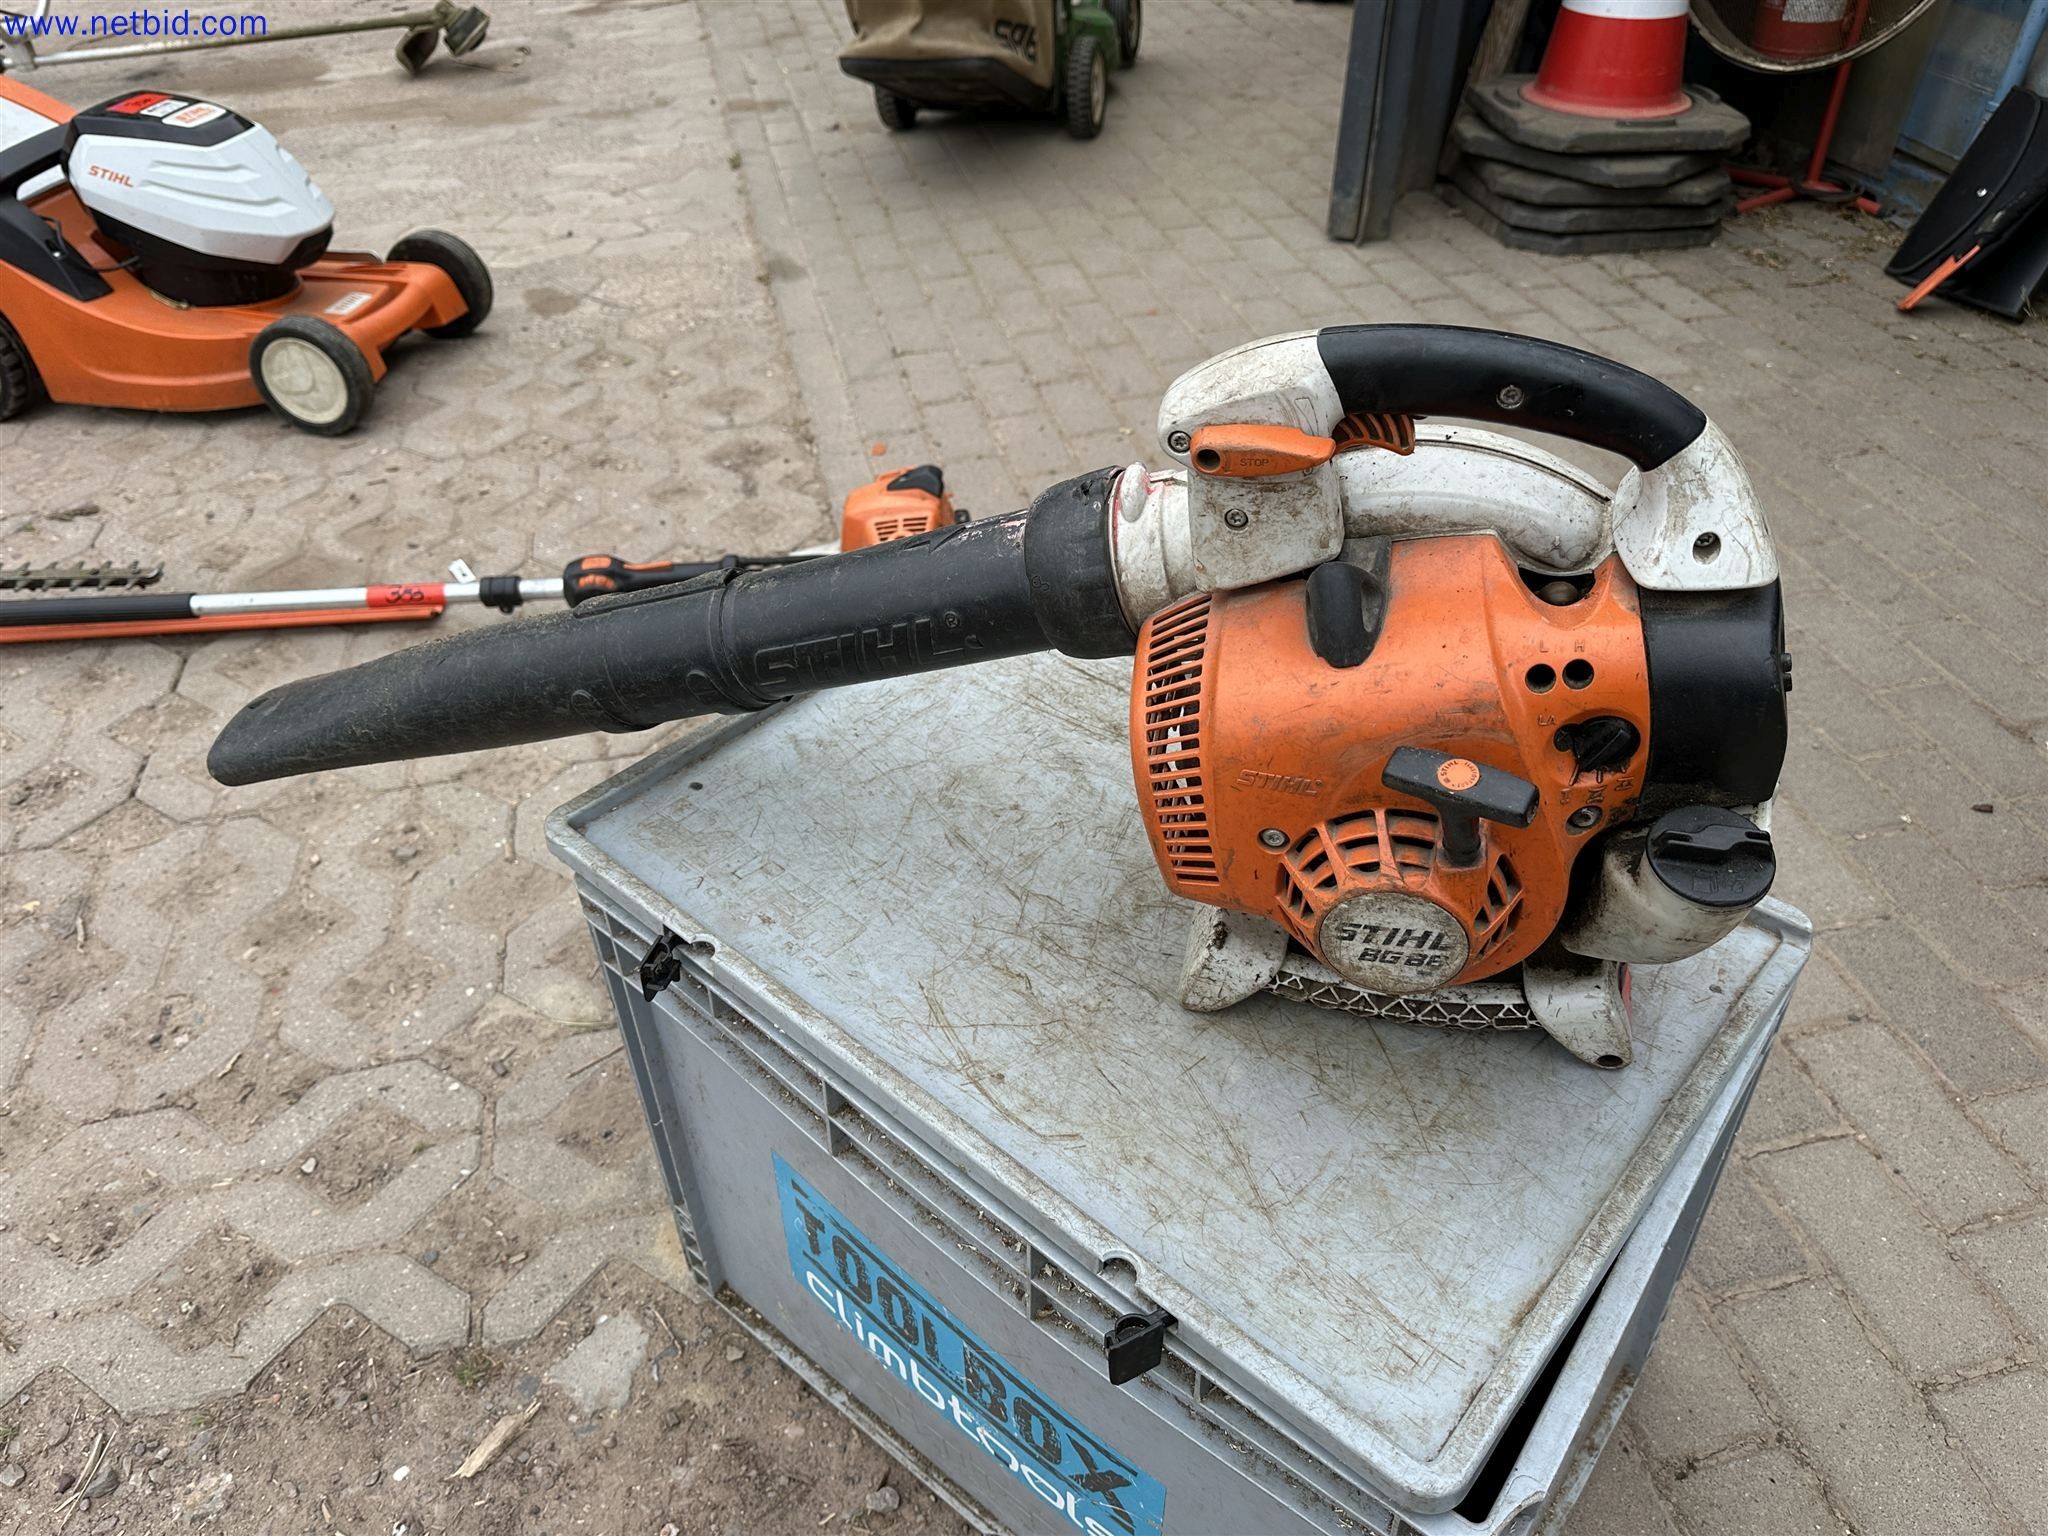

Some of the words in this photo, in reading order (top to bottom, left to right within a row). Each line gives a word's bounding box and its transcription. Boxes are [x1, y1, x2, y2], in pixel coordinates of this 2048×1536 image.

[88, 164, 134, 188] STIHL
[1240, 458, 1269, 467] STOP
[754, 616, 963, 688] STIHL
[1574, 640, 1585, 652] H
[1440, 760, 1459, 777] STIHL
[1236, 768, 1318, 796] STIHL
[1339, 923, 1451, 951] STIHL
[1358, 947, 1404, 965] BG
[962, 1341, 1132, 1526] BOX
